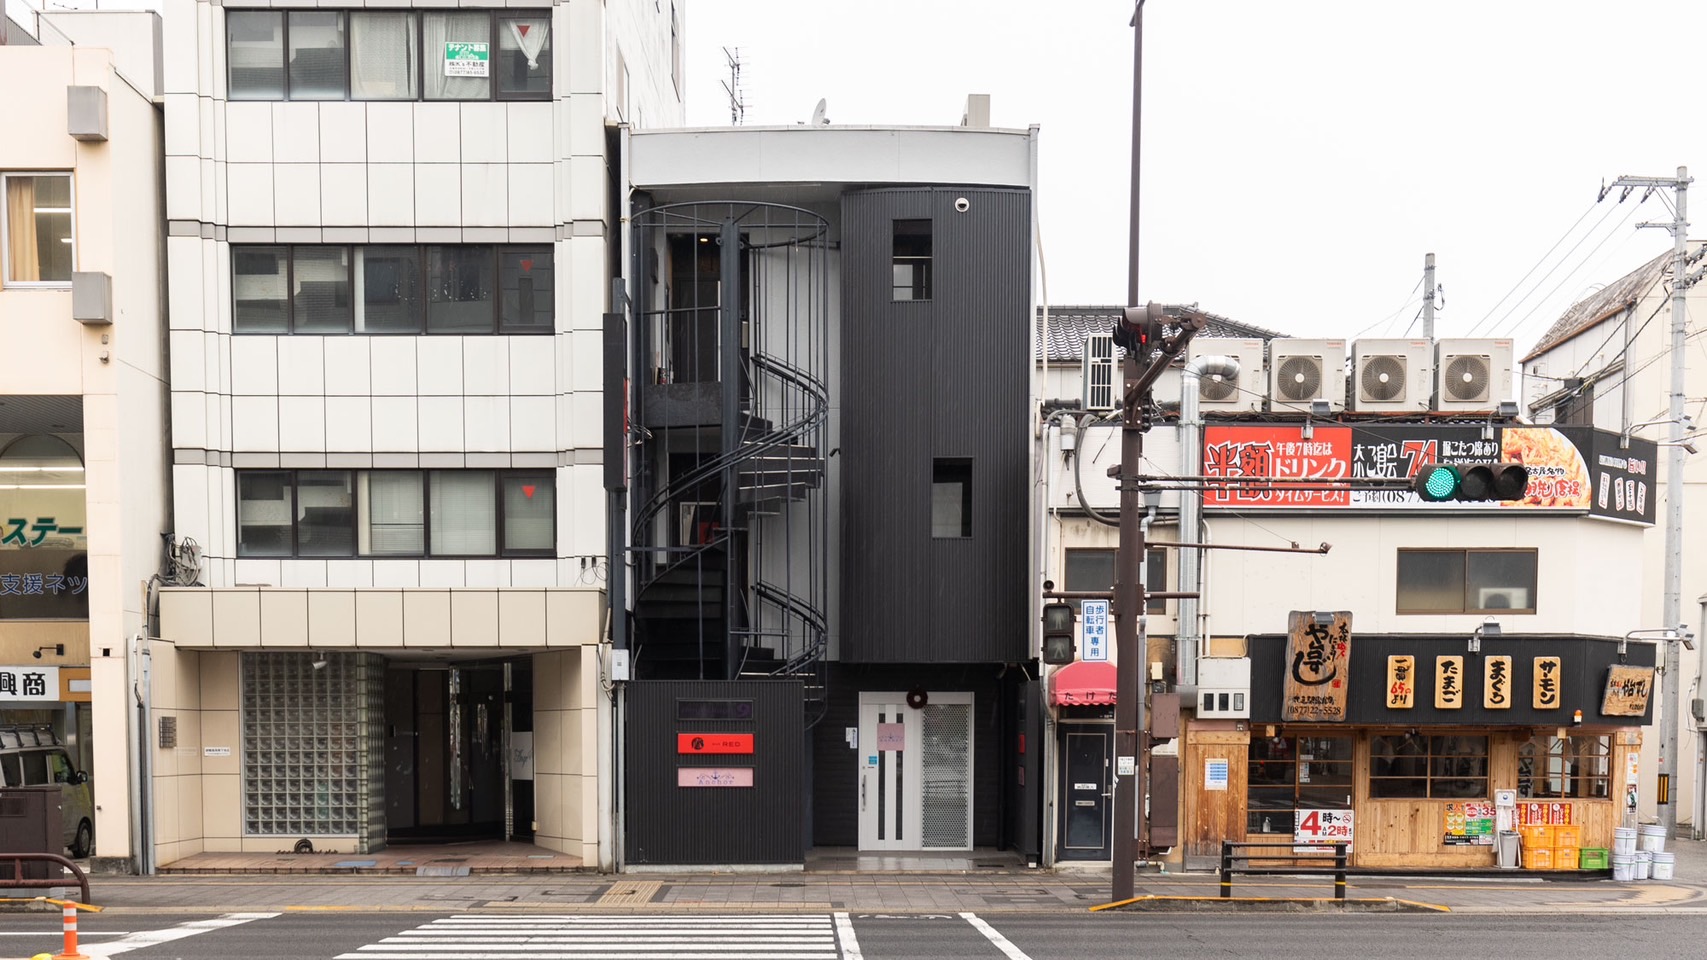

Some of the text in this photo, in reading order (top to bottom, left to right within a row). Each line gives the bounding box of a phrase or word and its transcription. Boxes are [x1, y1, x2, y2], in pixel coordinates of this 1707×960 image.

[1276, 442, 1333, 457] 午後7時迄は
[1204, 440, 1275, 502] 半額
[1275, 457, 1347, 482] ドリンク
[2, 517, 83, 546] ステー
[1086, 605, 1094, 635] 自転車
[1096, 605, 1104, 635] 歩行者
[1090, 636, 1100, 657] 専用
[1440, 660, 1461, 703] たまご
[1490, 660, 1506, 704] まぐろ
[1539, 660, 1557, 704] サーモン
